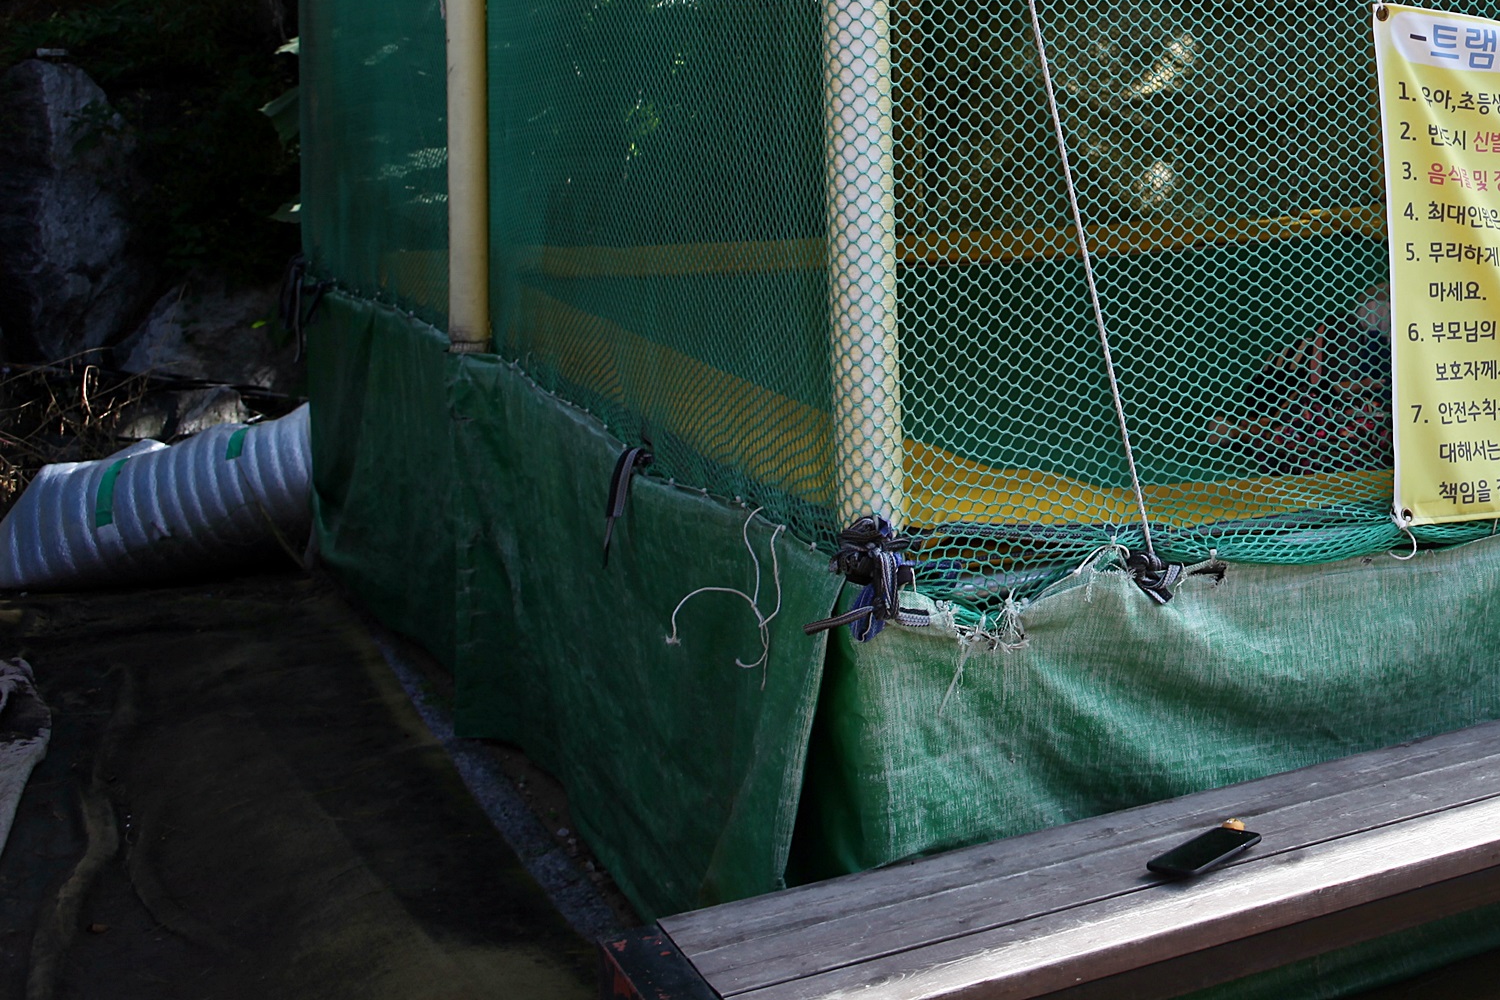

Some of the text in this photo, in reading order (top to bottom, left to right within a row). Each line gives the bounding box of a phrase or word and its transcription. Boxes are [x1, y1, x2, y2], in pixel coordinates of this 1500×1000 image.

[1398, 81, 1417, 102] 1.
[1400, 121, 1417, 141] 2.
[1428, 124, 1467, 150] 반드시
[1402, 161, 1418, 181] 3.
[1427, 162, 1472, 190] 음식물
[1473, 170, 1489, 192] 및
[1404, 202, 1419, 221] 4.
[1406, 242, 1420, 262] 5.
[1428, 242, 1500, 267] 무리하게
[1429, 281, 1487, 302] 마세요.
[1408, 322, 1424, 342] 6.
[1432, 320, 1497, 343] 부모님의
[1410, 404, 1429, 424] 7.
[1439, 439, 1500, 463] 대해서는
[1438, 479, 1492, 505] 책임을
